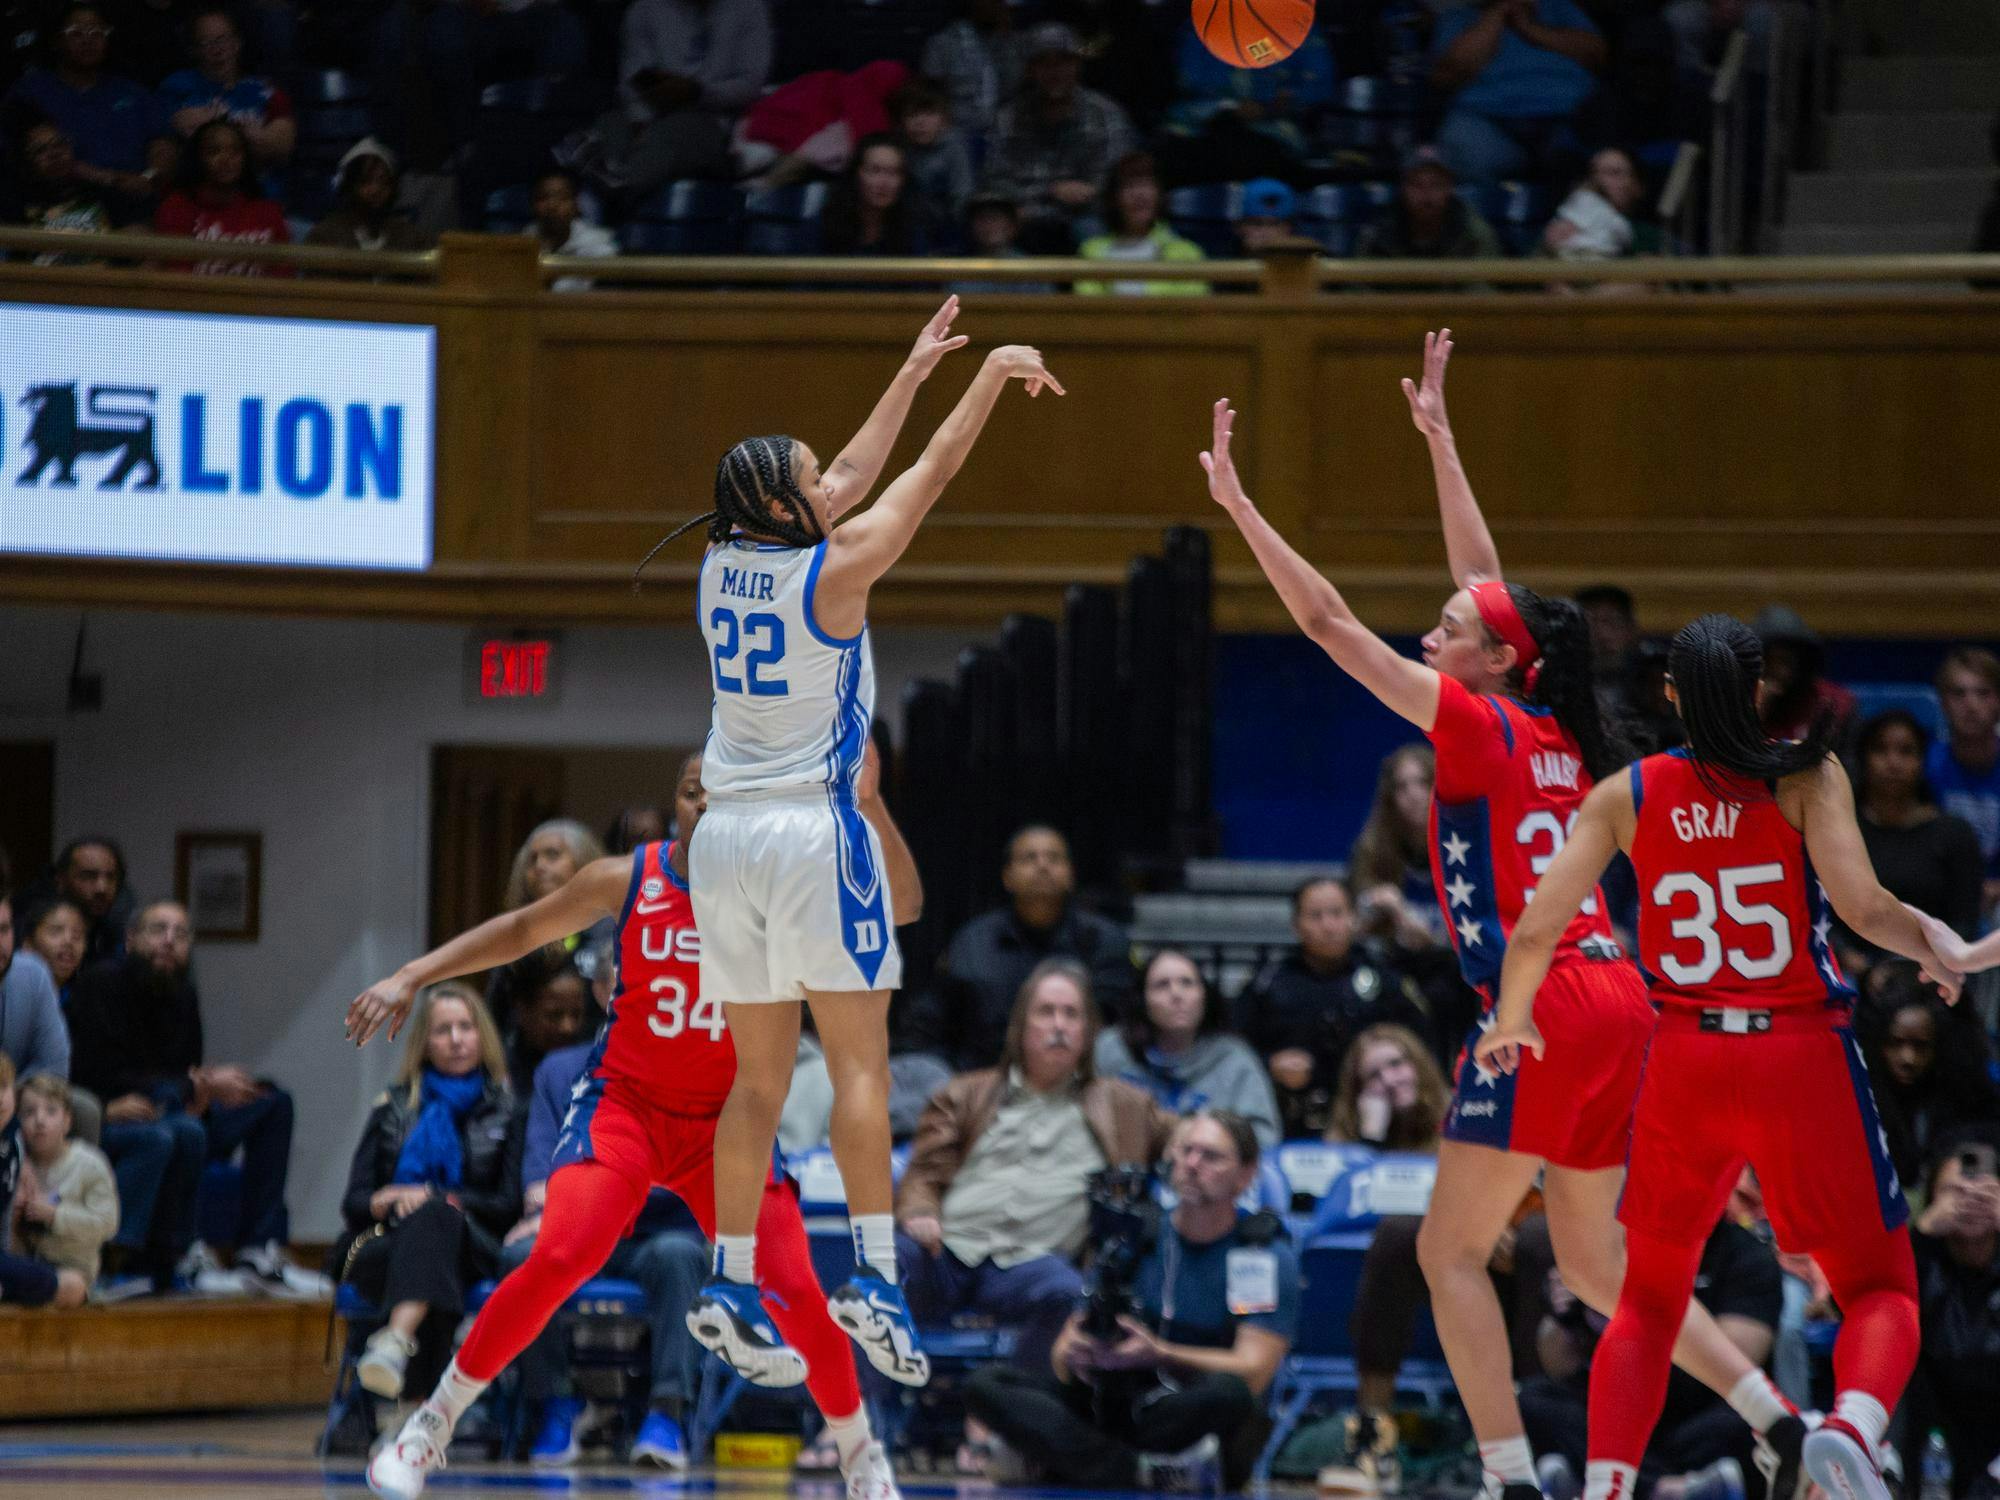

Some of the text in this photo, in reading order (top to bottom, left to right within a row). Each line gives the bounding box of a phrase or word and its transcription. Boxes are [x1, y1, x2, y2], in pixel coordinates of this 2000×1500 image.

[180, 393, 403, 502] LION
[720, 566, 774, 601] MAIR
[481, 640, 549, 698] EXIT
[710, 607, 789, 696] 22
[1671, 800, 1743, 843] GRAY
[1516, 809, 1598, 916] 3
[641, 927, 702, 963] US
[853, 920, 881, 954] D
[1653, 863, 1792, 985] 35
[647, 975, 727, 1042] 34
